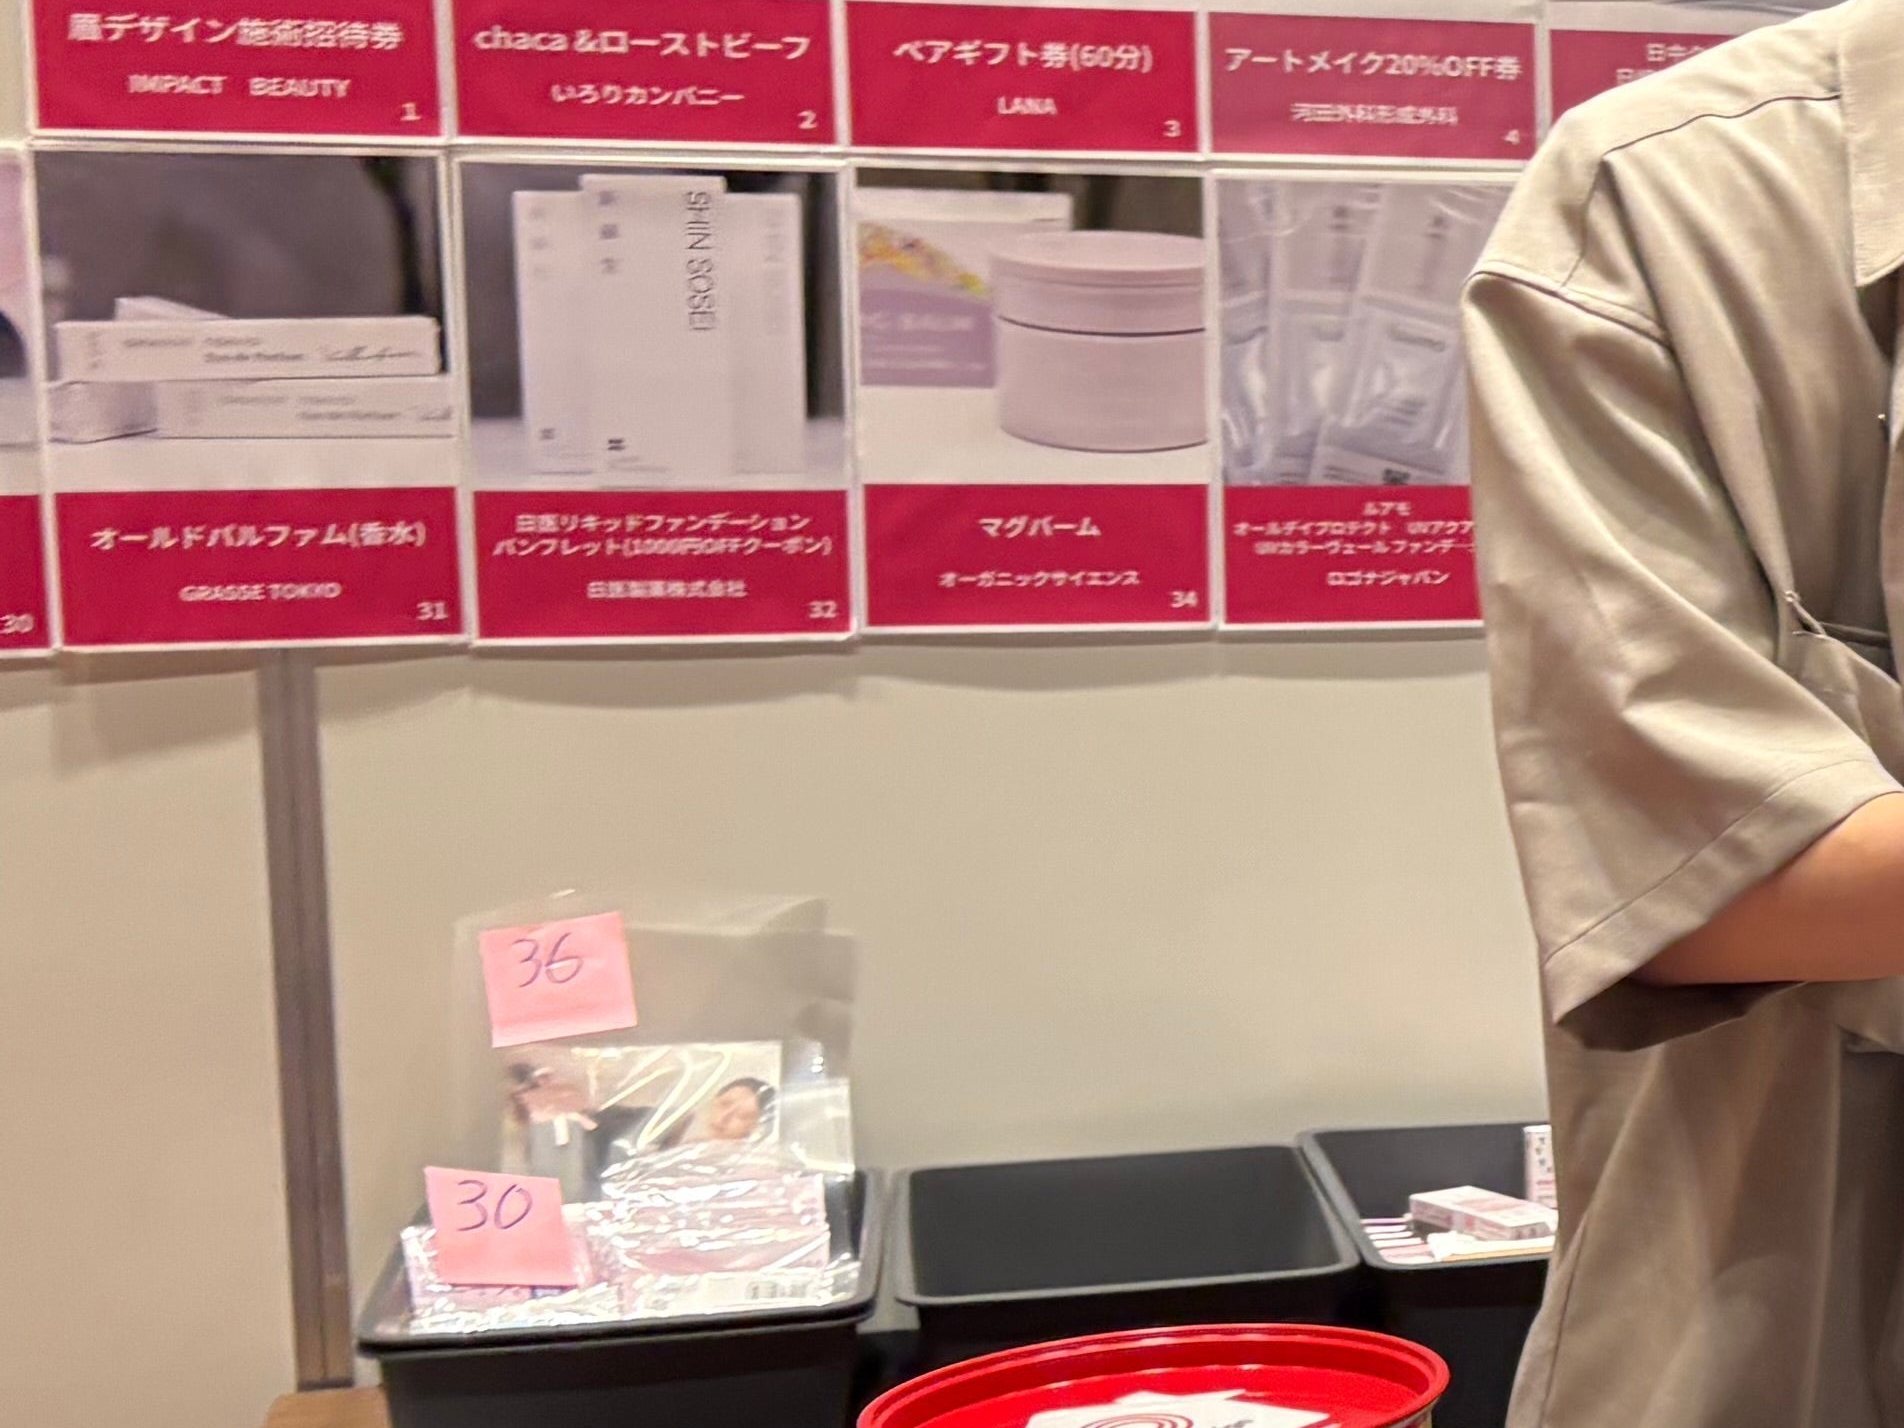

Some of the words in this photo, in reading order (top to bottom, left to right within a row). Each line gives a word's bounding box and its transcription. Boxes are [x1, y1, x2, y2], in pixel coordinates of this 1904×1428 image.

[1224, 47, 1522, 81] アートメイク20%OFF券
[127, 74, 227, 94] IMPACT
[247, 77, 351, 98] BEAUTY
[997, 95, 1057, 116] LANA
[798, 110, 818, 130] 2
[1164, 120, 1181, 139] 3
[1504, 129, 1521, 146] 4
[938, 568, 1142, 588] オーガニックサイエンス
[1171, 588, 1197, 609] 34
[417, 601, 447, 622] 31
[808, 600, 837, 619] 32
[512, 932, 583, 988] 36
[456, 1179, 533, 1231] 30
